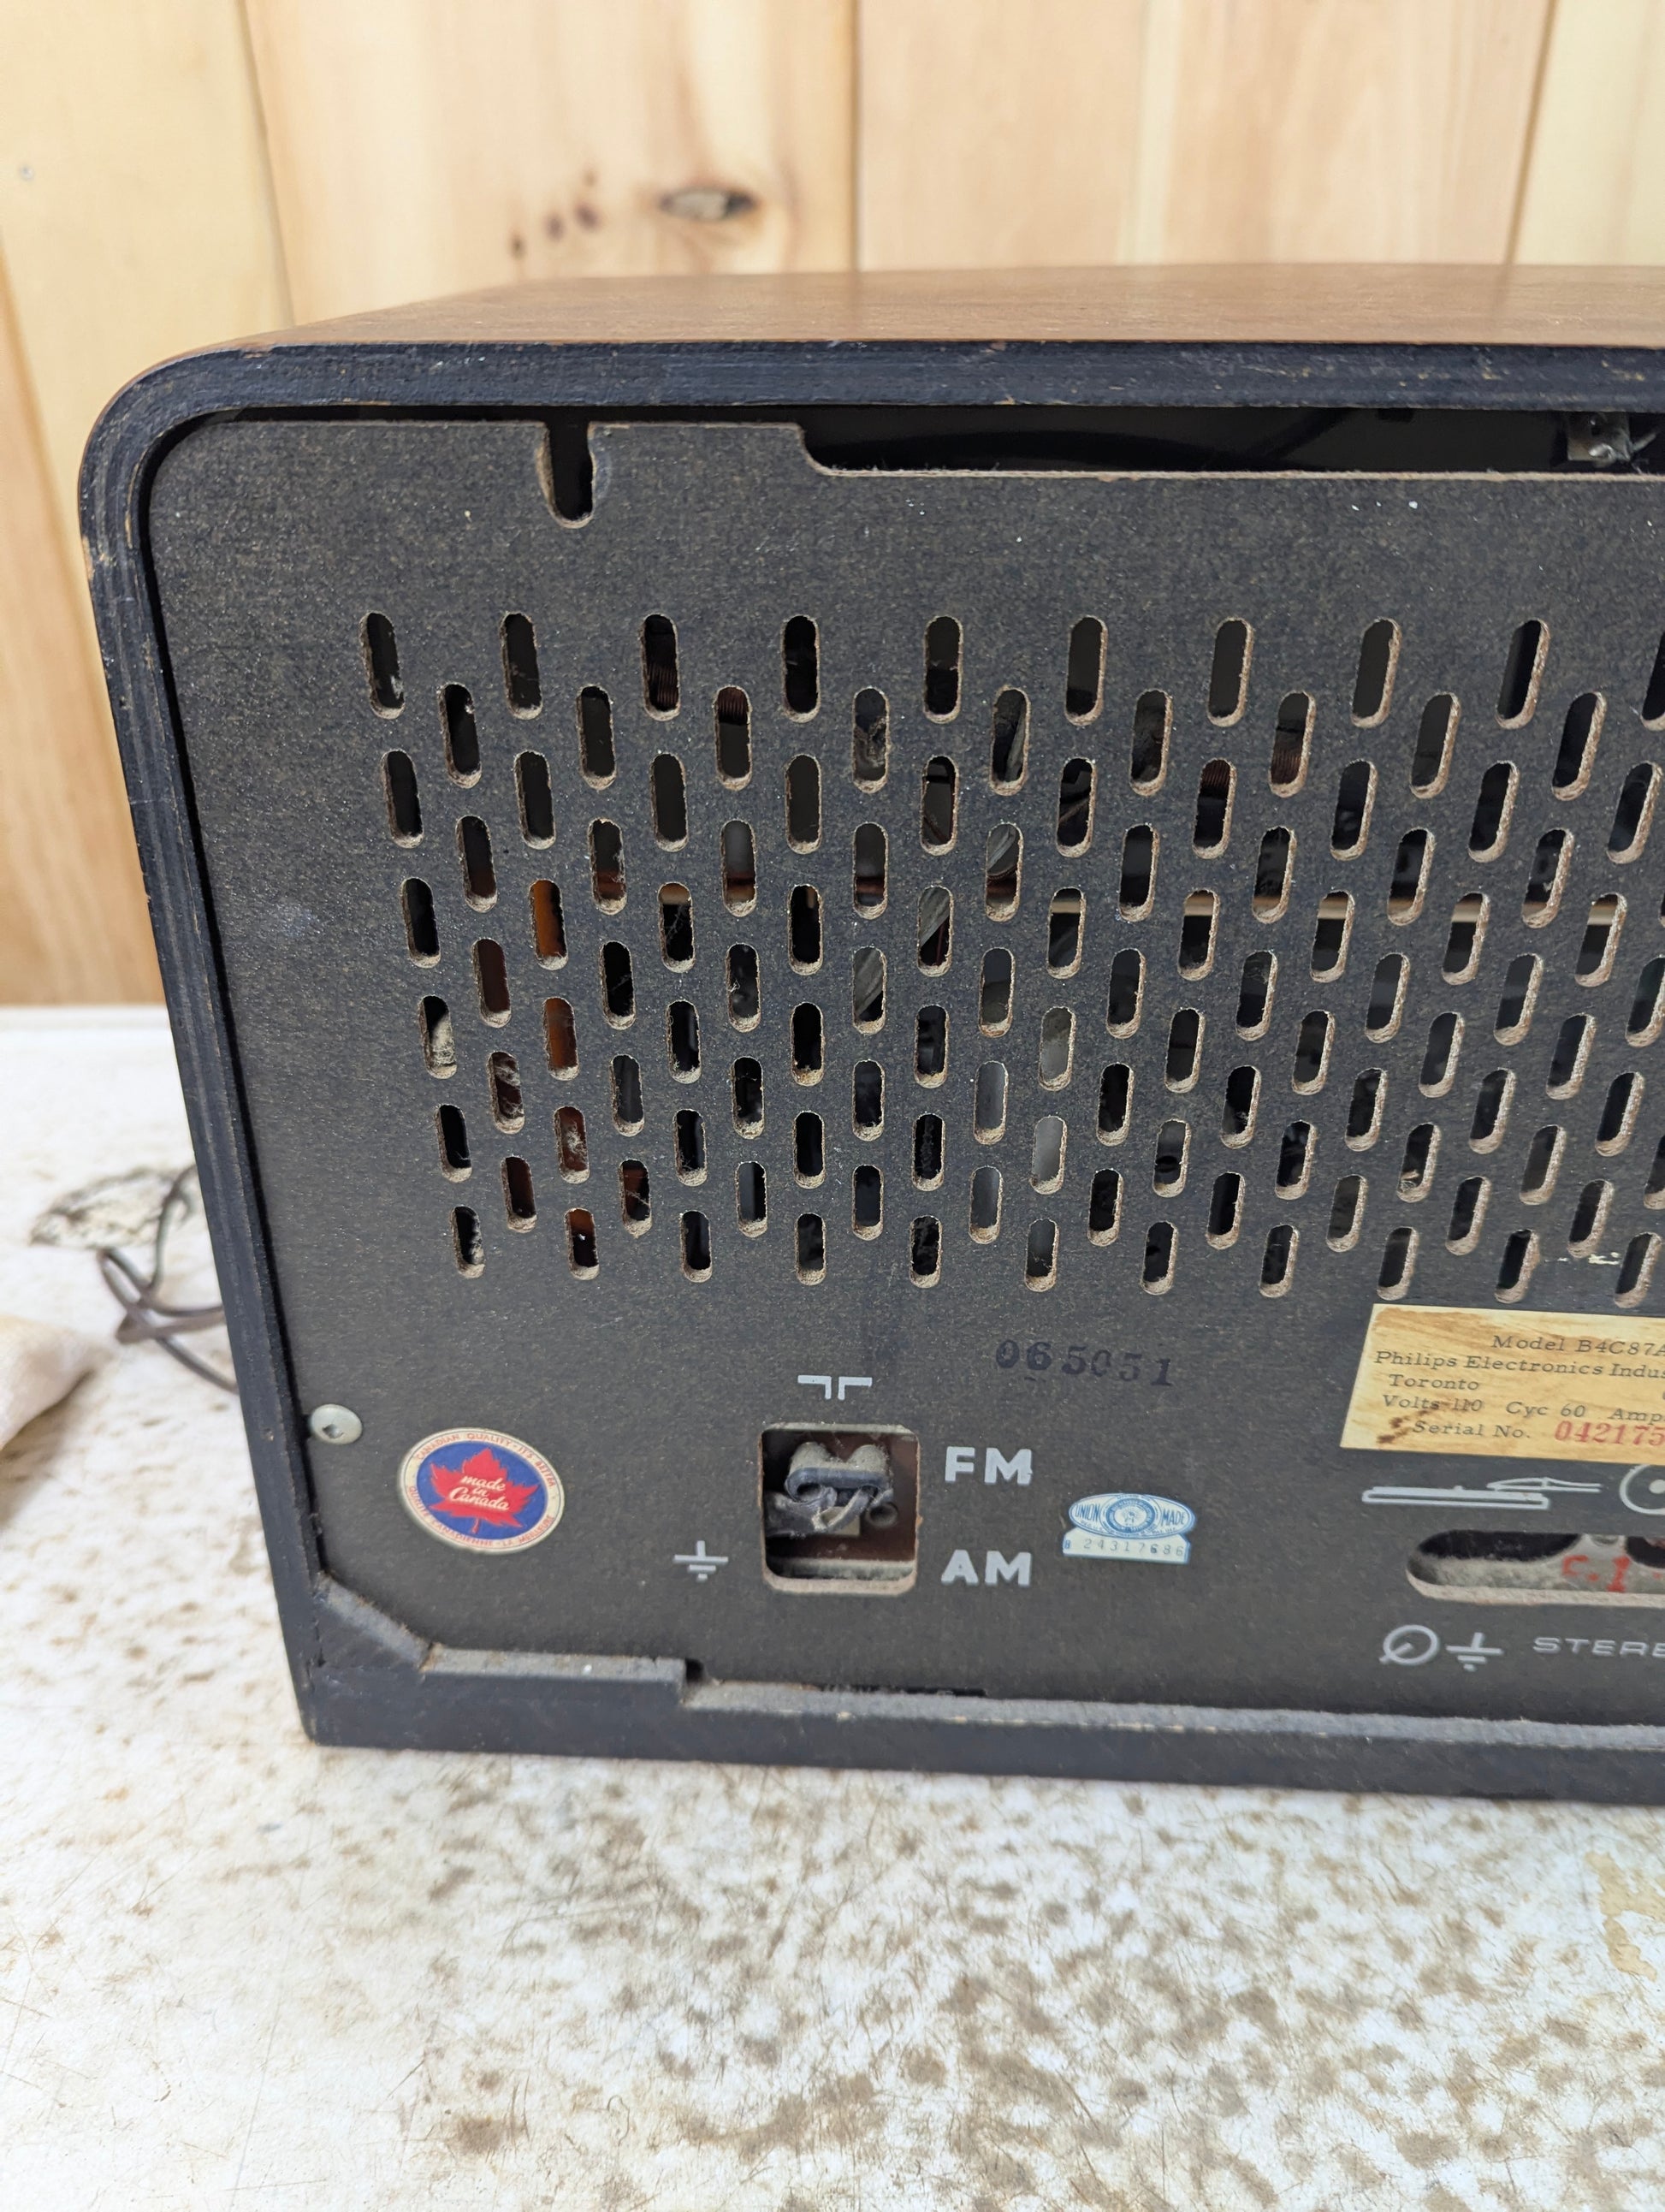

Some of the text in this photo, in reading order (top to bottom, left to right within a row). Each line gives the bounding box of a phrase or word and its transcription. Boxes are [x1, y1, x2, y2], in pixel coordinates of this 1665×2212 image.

[1491, 1335, 1564, 1351] Model
[1373, 1350, 1457, 1370] Philips
[1464, 1355, 1603, 1375] Electronics
[1389, 1374, 1479, 1391] Toronto
[1383, 1394, 1440, 1410] Volts
[1451, 1397, 1483, 1412] 110
[1506, 1401, 1549, 1419] Cyc
[1561, 1403, 1586, 1418] 60
[1412, 1420, 1484, 1437] Serial
[1492, 1425, 1531, 1438] No.
[417, 1433, 459, 1460] CANADIAN
[467, 1432, 513, 1446] QUALITY
[945, 1446, 1033, 1486] FM
[460, 1475, 506, 1491] made
[472, 1486, 489, 1497] in
[449, 1486, 509, 1511] Canada
[1075, 1503, 1186, 1527] UNION MADE
[941, 1549, 1032, 1586] AM
